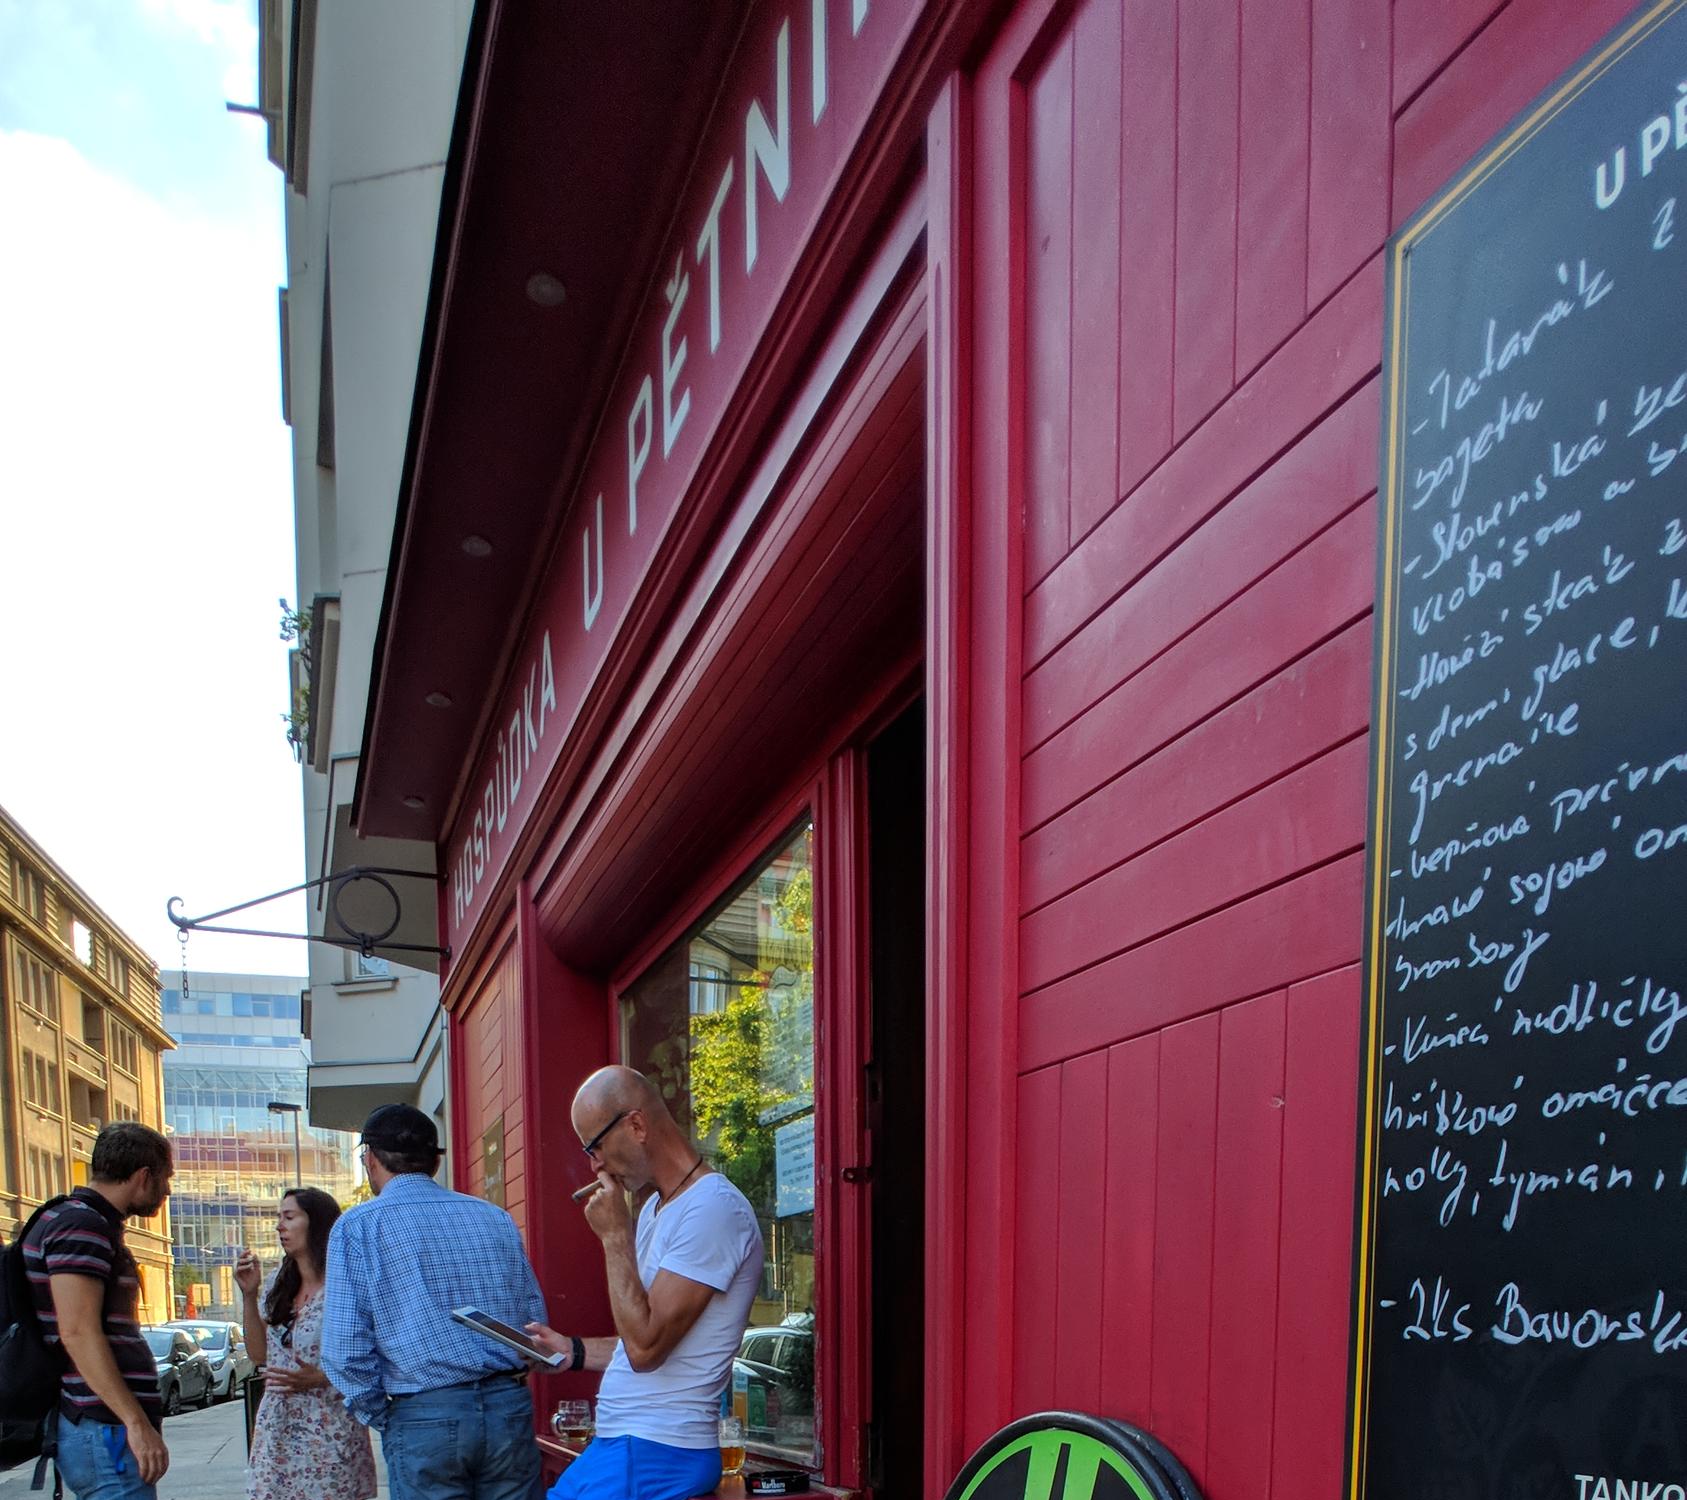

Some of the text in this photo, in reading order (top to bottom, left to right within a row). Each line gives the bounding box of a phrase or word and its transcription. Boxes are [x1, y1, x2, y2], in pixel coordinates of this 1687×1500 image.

[1595, 146, 1626, 211] U
[453, 0, 870, 930] HOSPŮDKA U PĚTN
